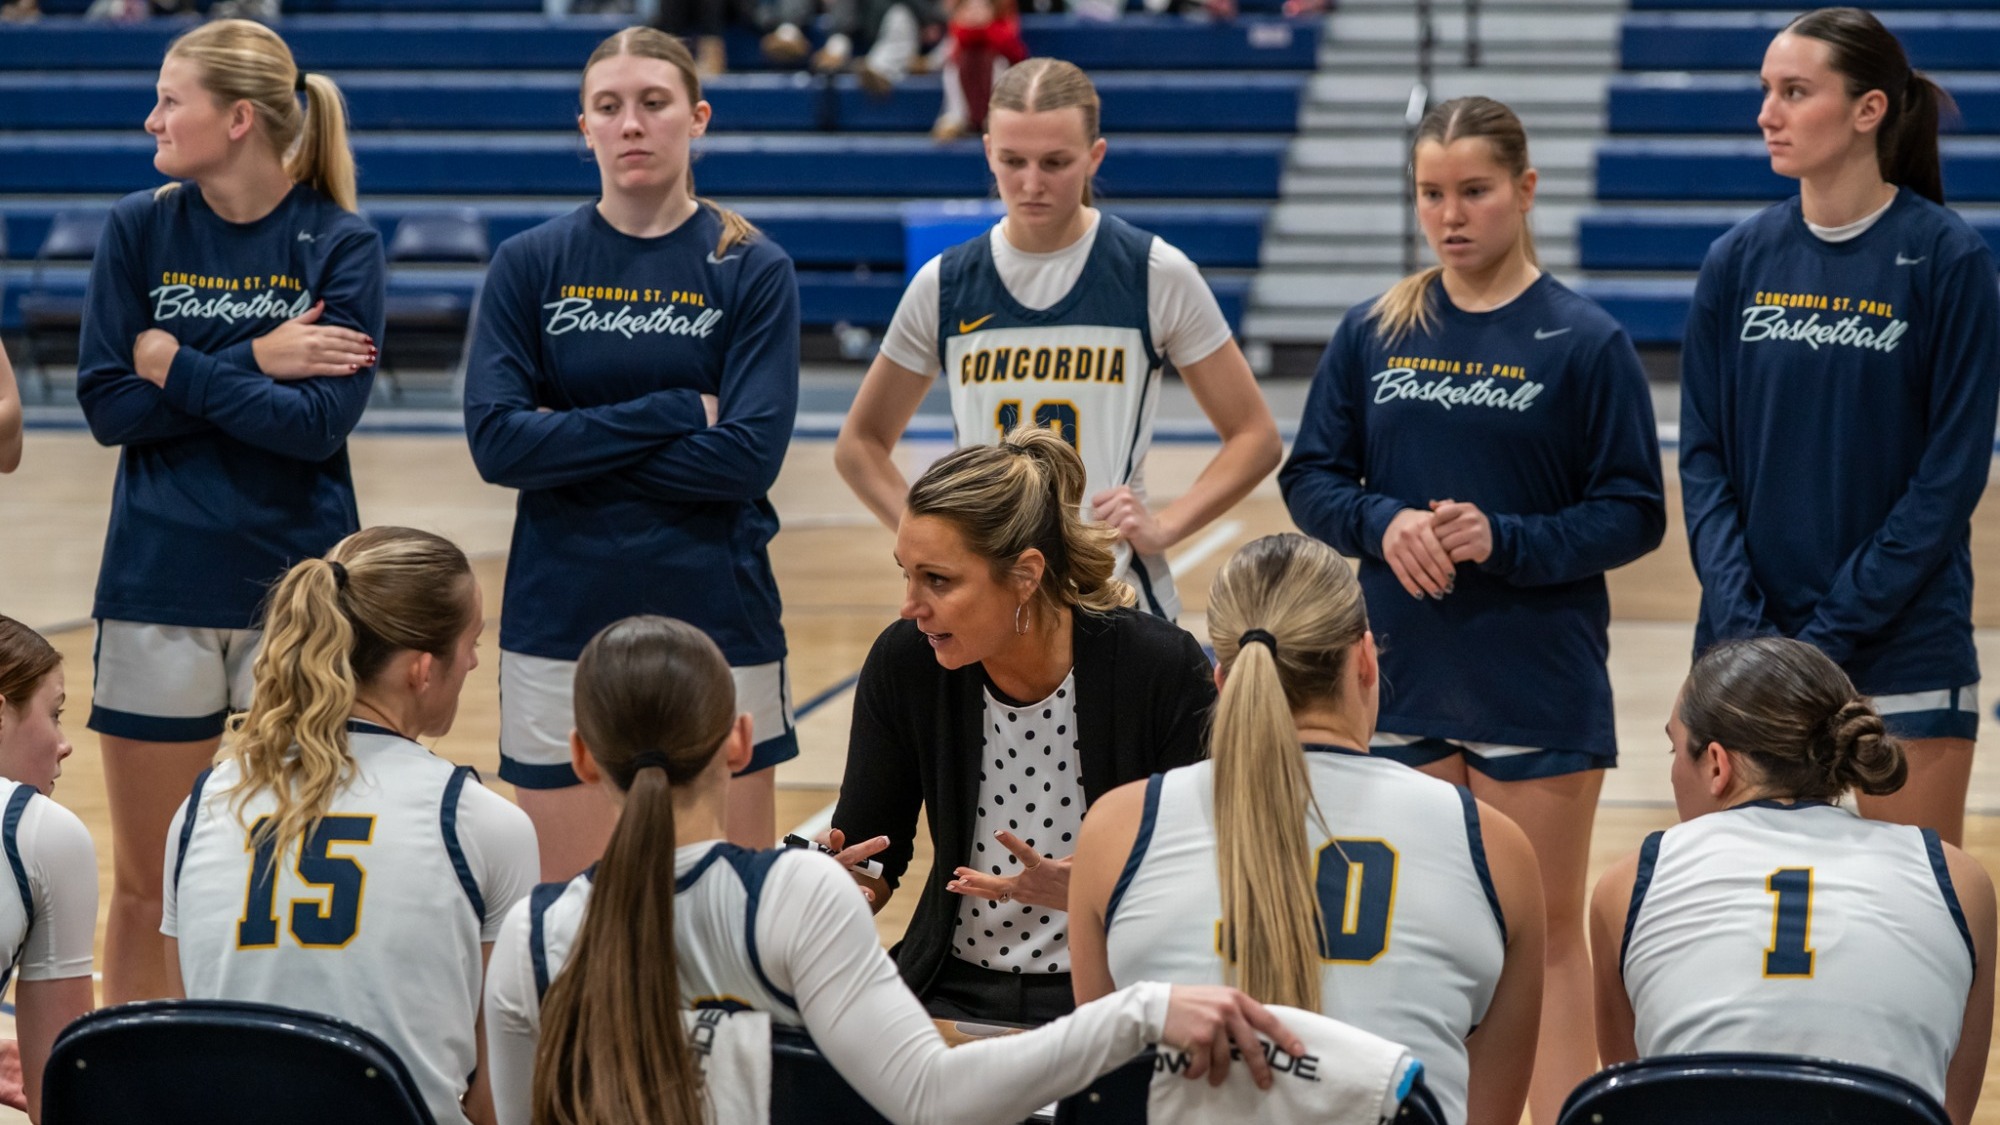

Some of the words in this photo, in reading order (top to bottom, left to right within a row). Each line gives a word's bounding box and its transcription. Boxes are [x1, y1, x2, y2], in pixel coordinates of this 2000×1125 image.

[162, 271, 239, 291] CONCORDIA
[244, 276, 266, 290] ST.
[560, 285, 639, 302] CONCORDIA
[644, 288, 666, 303] ST.
[671, 290, 705, 307] PAUL
[542, 296, 724, 340] Basketball
[1756, 291, 1828, 310] CONCORDIA
[1832, 297, 1854, 311] ST.
[1858, 299, 1893, 318] PAUL
[1739, 305, 1909, 353] Basketball
[961, 346, 1124, 386] CONCORDIA
[1387, 356, 1461, 375] CONCORDIA
[1465, 362, 1487, 376] ST.
[1491, 363, 1526, 381] PAUL
[1371, 367, 1545, 413] Basketball
[235, 812, 377, 951] 15
[1762, 866, 1816, 979] 1
